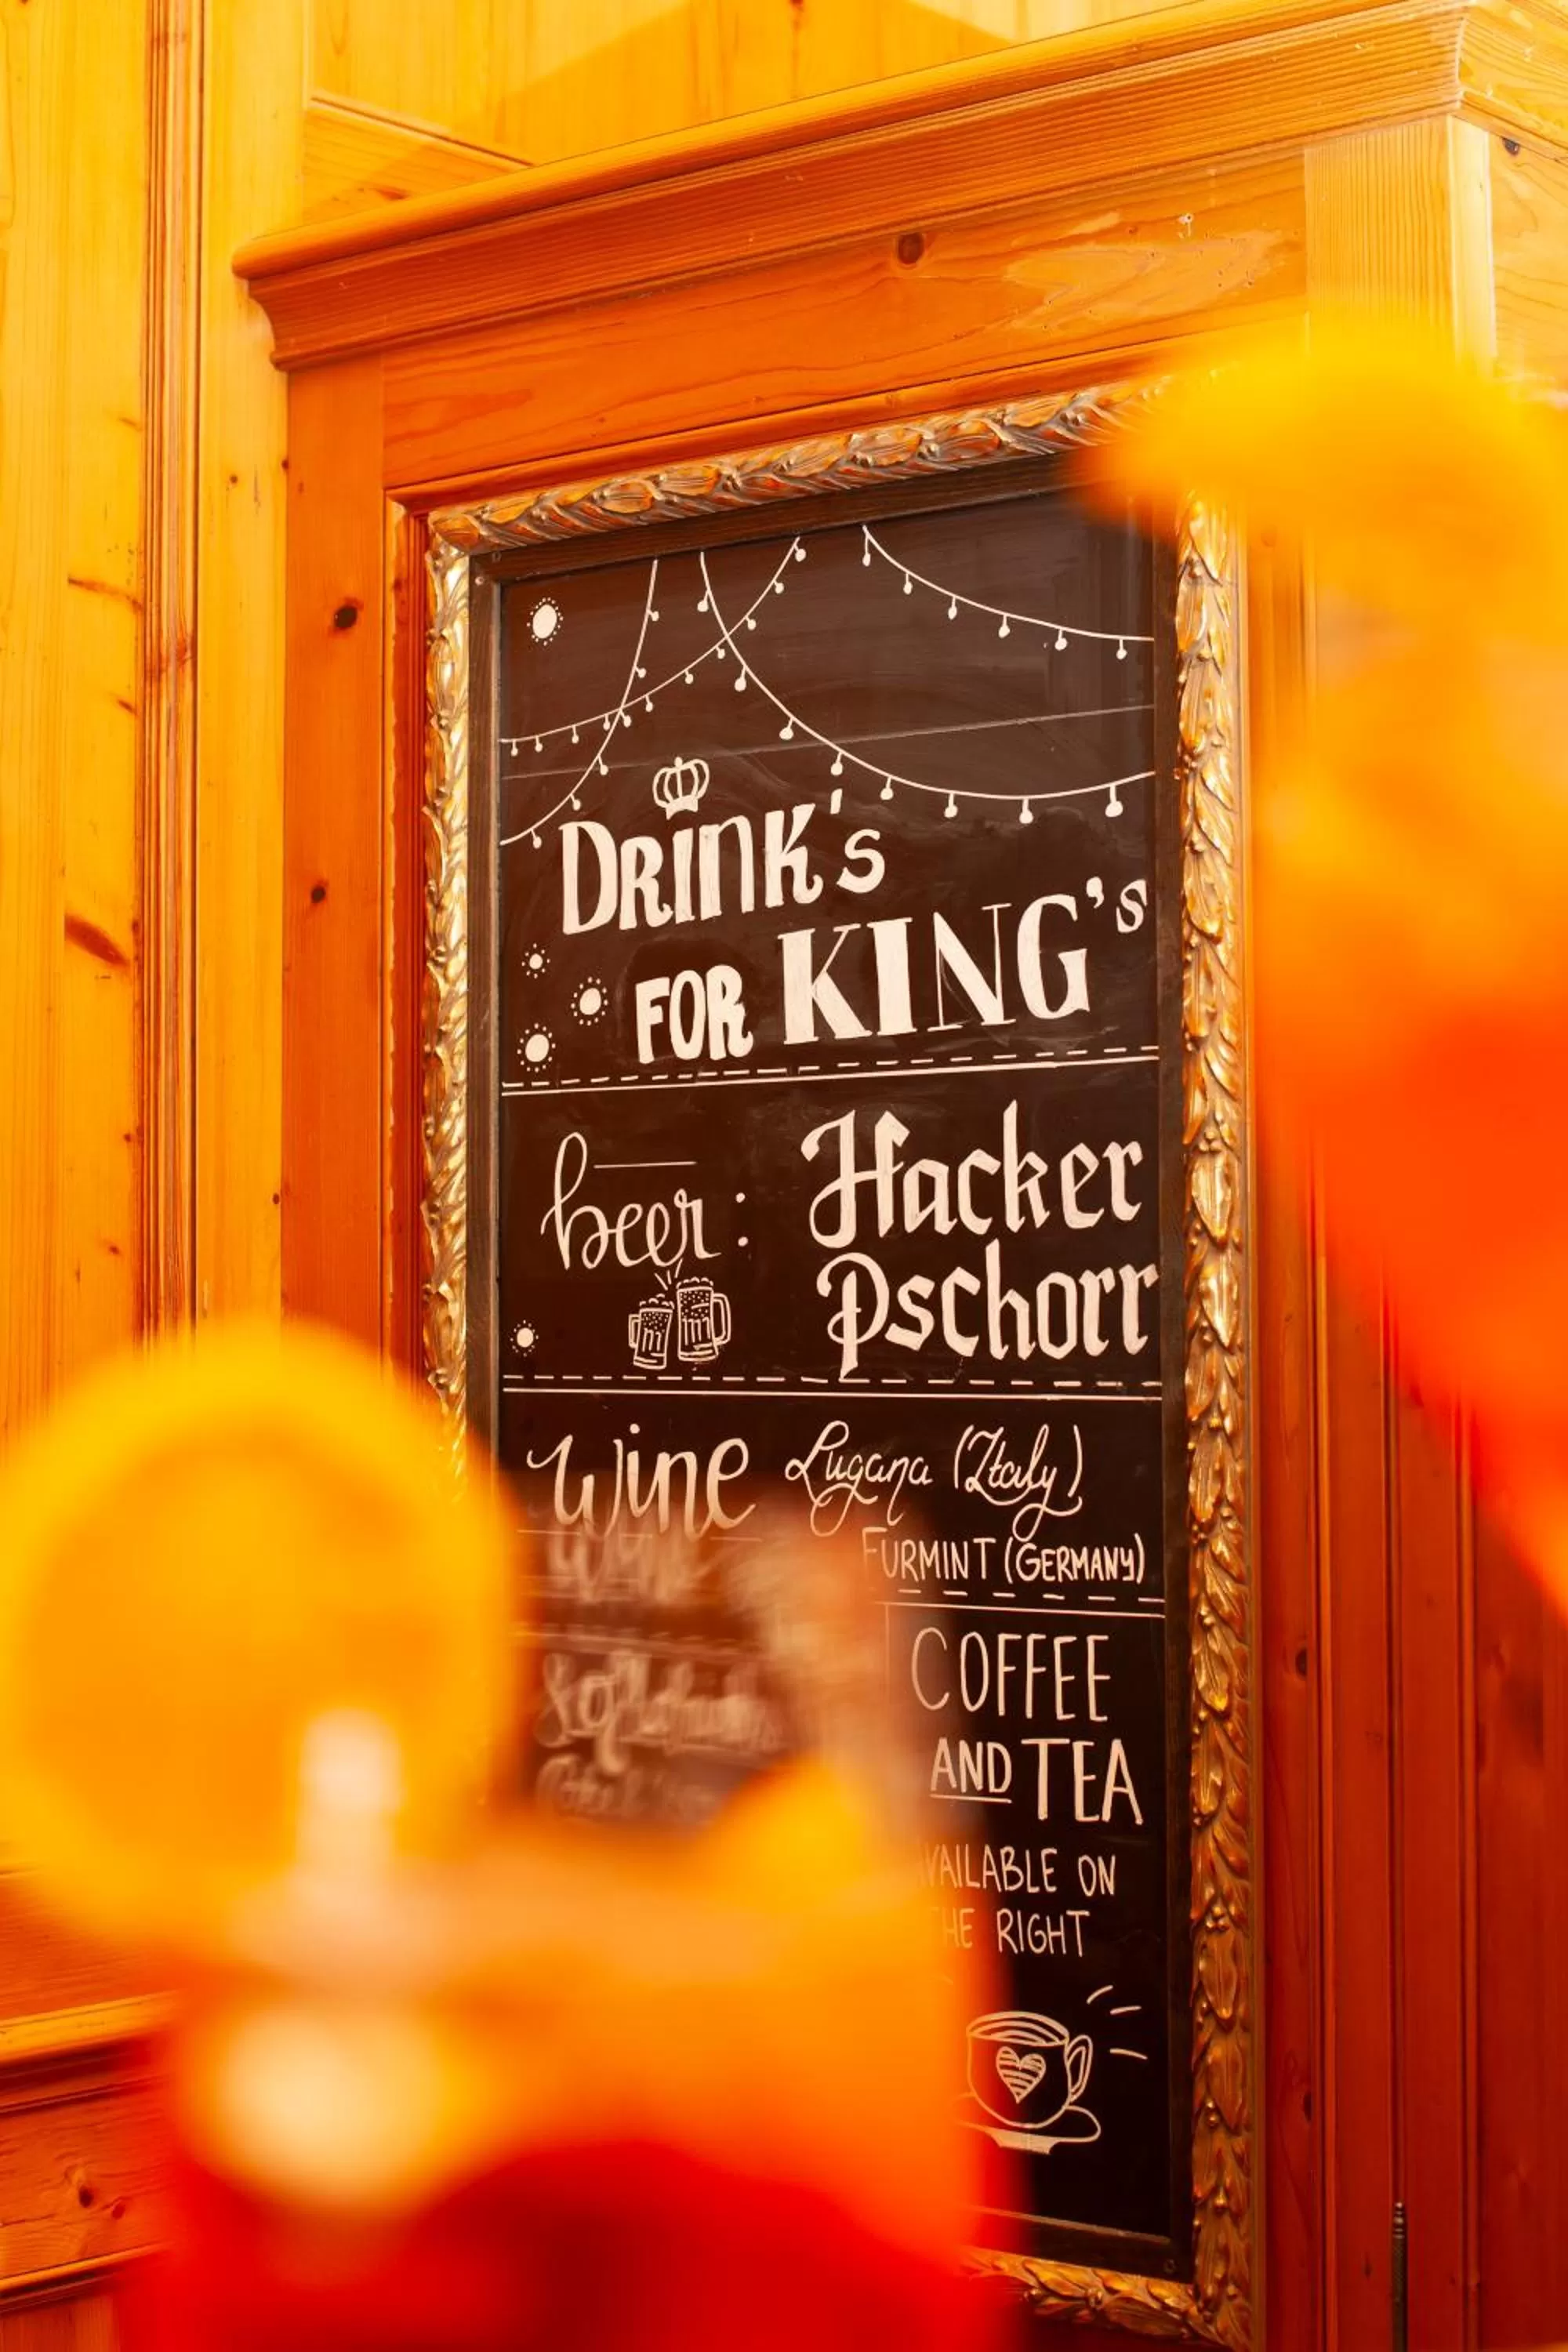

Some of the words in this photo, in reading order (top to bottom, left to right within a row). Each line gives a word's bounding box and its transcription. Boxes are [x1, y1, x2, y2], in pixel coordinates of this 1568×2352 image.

[636, 964, 753, 1064] FOR
[778, 877, 1148, 1045] KING's
[800, 1100, 1144, 1249] Hacker
[817, 1239, 1160, 1379] Pschorr
[526, 1424, 757, 1542] Wine
[785, 1420, 933, 1537] Lugana
[862, 1526, 996, 1581] FURMINT
[1004, 1533, 1145, 1584] (GERMANY)
[912, 1627, 1111, 1722] COFFEE
[930, 1737, 1013, 1794] AND
[1021, 1738, 1144, 1825] TEA
[1078, 1853, 1116, 1897] ON
[996, 1908, 1090, 1958] RIGHT
